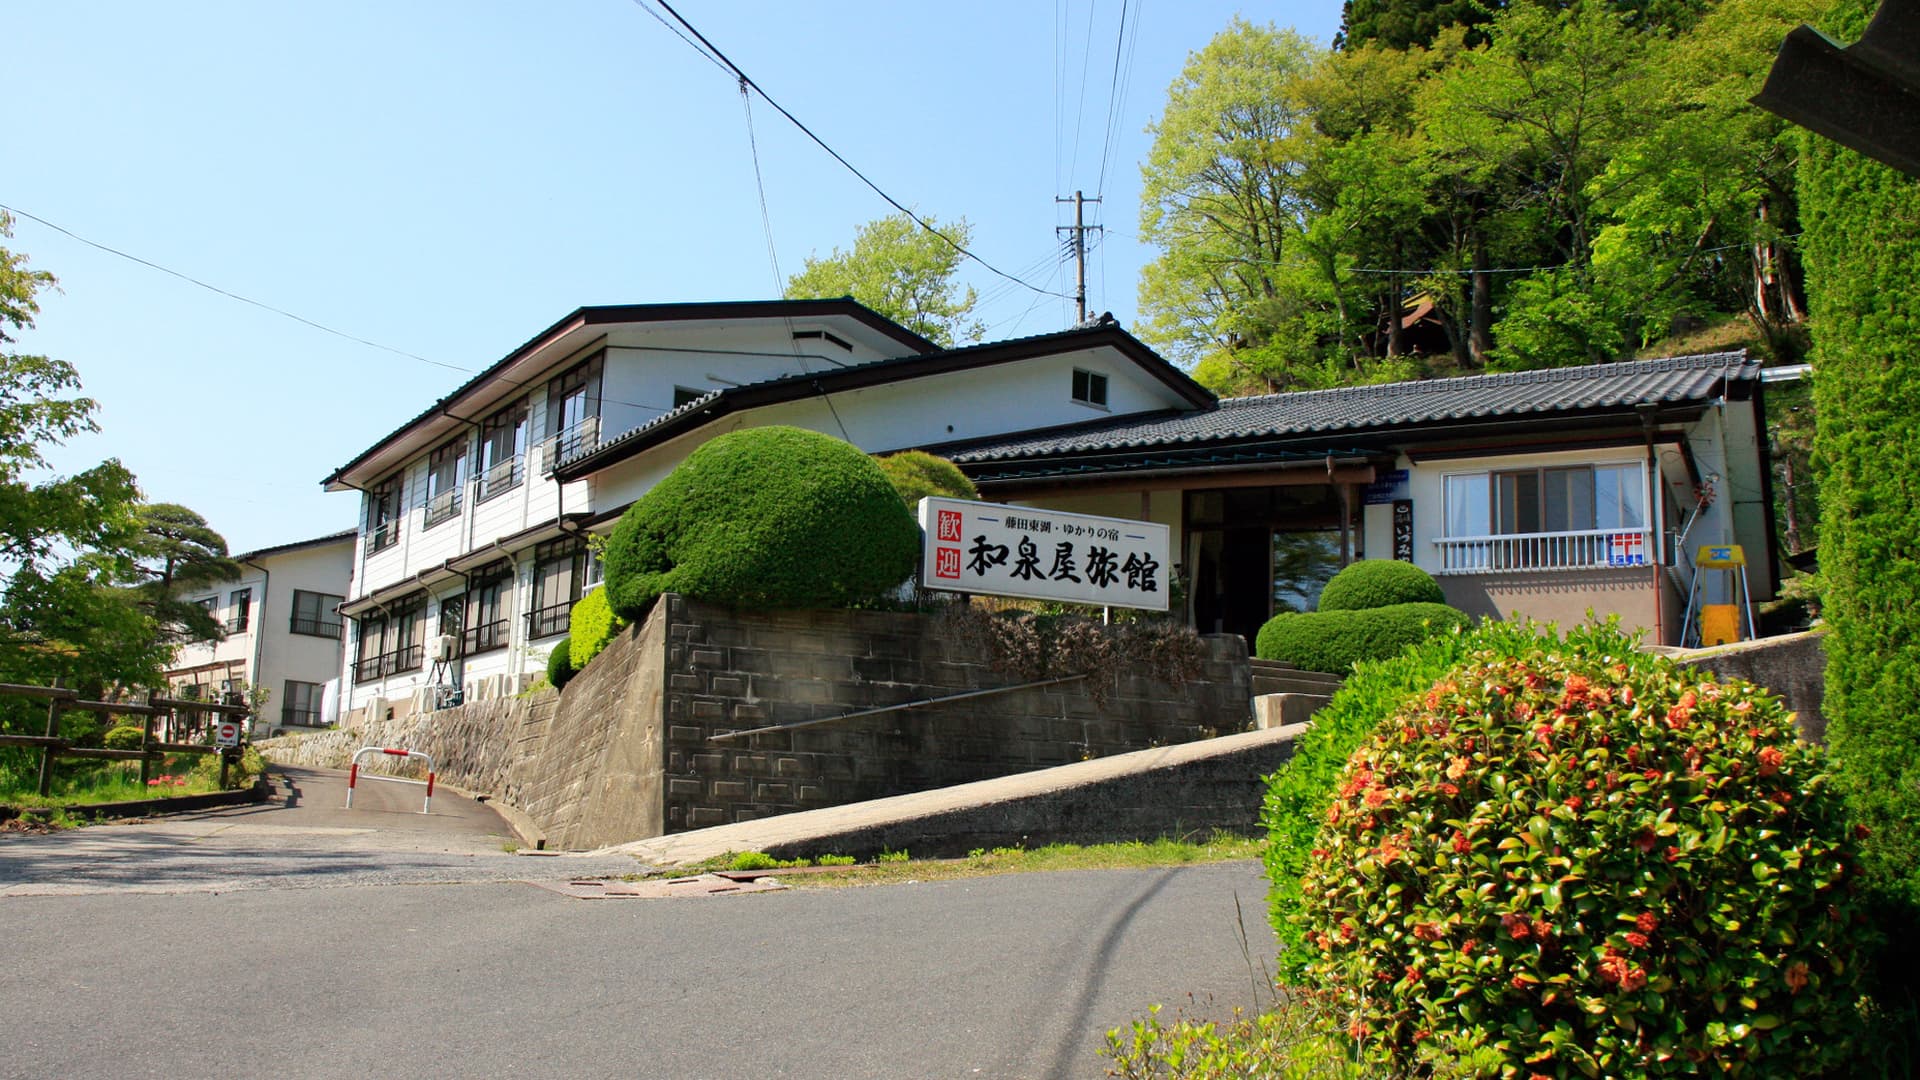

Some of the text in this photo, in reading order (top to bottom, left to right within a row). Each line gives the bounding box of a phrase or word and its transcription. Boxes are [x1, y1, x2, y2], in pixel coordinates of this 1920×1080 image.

[937, 511, 961, 578] 歓迎
[1005, 516, 1119, 541] 藤田東湖・ゆかりの宿
[966, 534, 1160, 592] 和泉屋旅館
